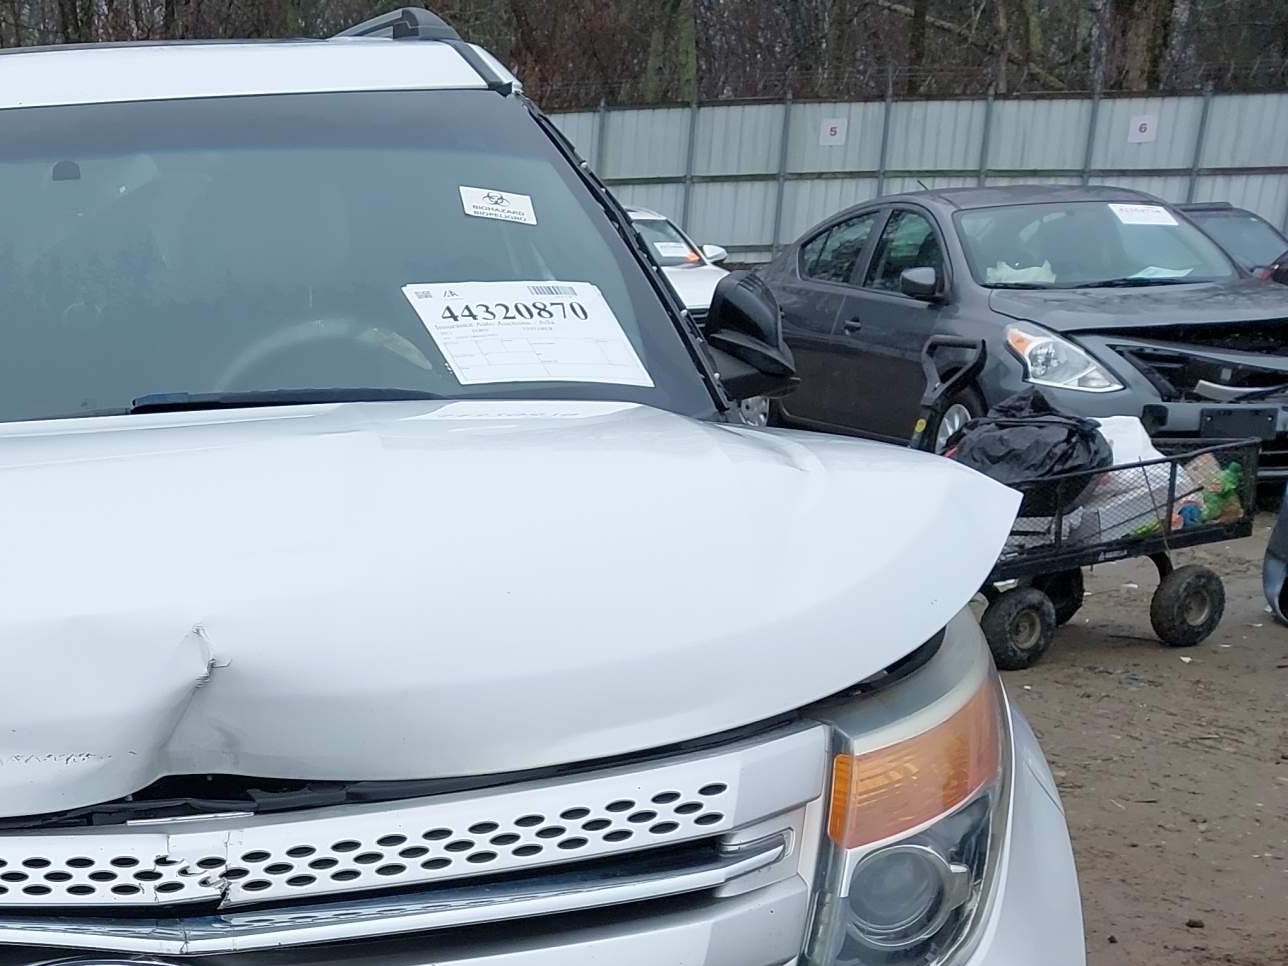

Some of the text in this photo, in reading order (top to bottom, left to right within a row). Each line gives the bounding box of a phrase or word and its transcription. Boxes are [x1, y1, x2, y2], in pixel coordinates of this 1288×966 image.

[829, 126, 838, 137] 5
[1138, 122, 1148, 134] 6
[472, 204, 525, 217] BIOHAZARD
[441, 301, 589, 322] 44320870
